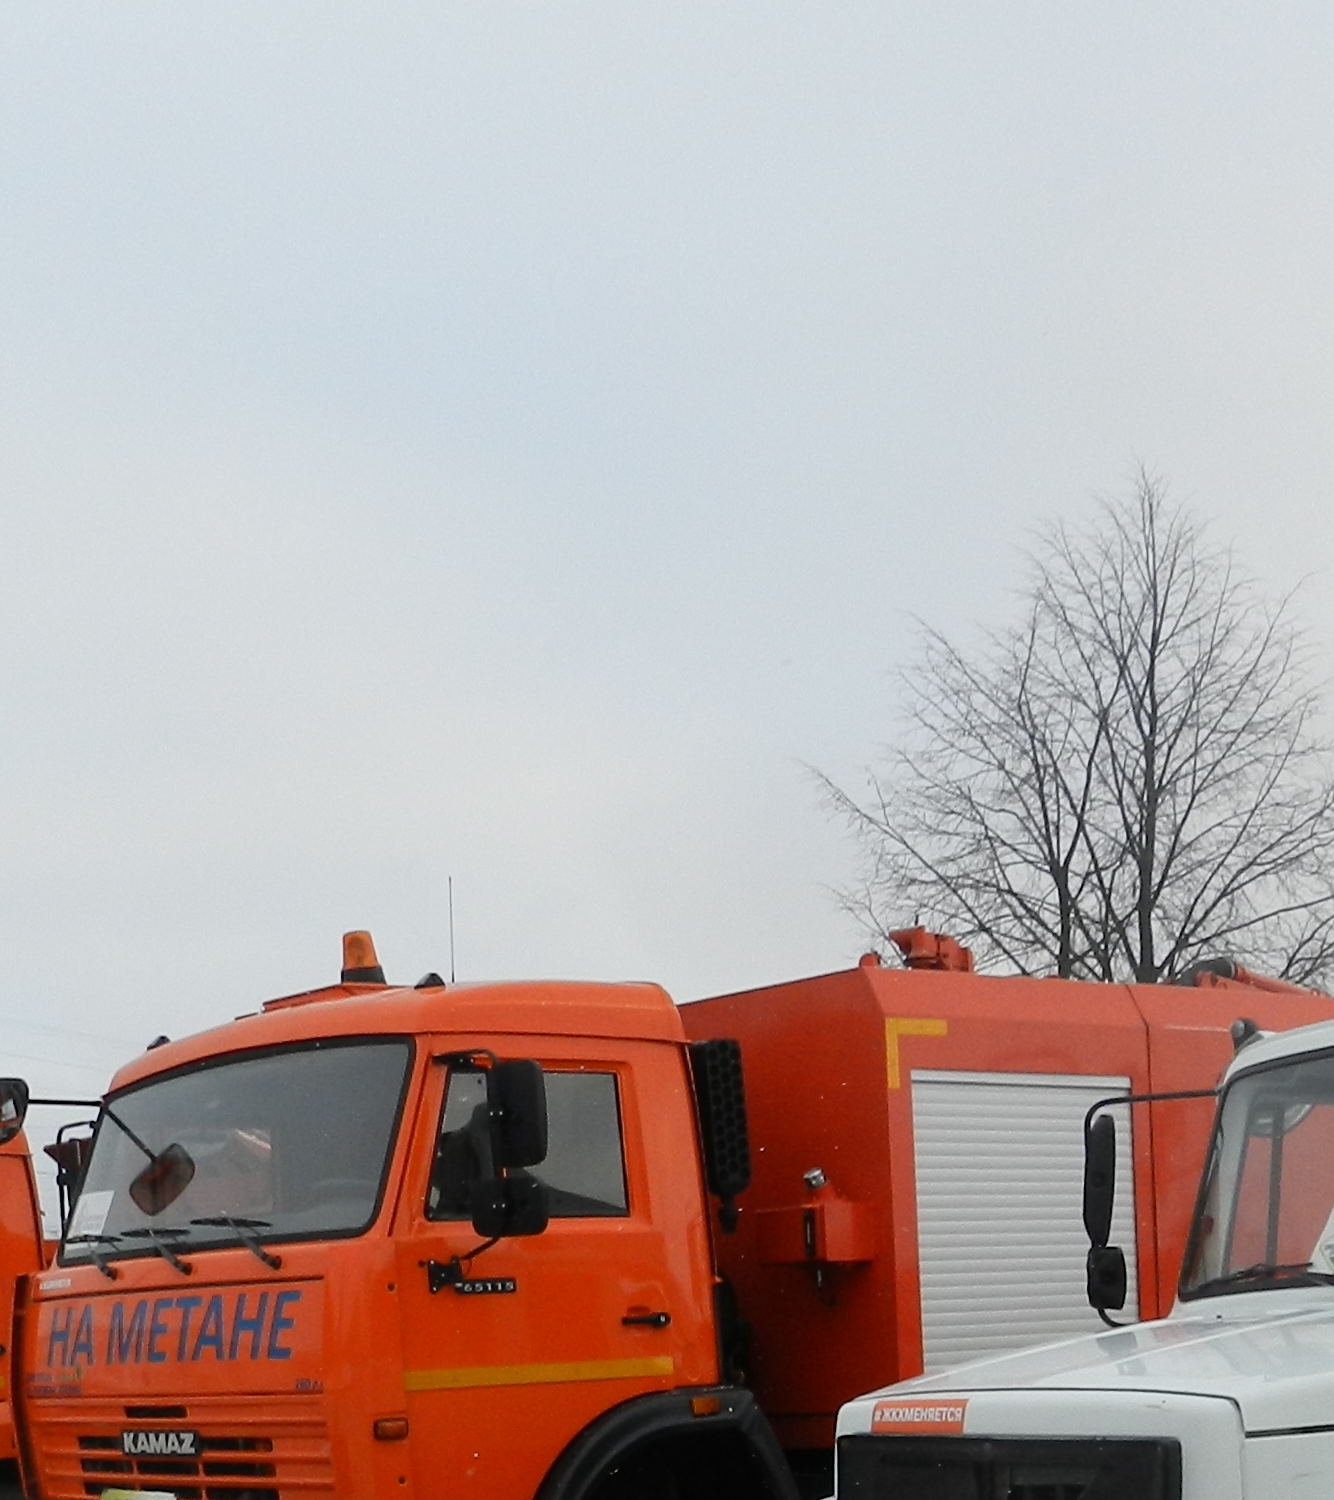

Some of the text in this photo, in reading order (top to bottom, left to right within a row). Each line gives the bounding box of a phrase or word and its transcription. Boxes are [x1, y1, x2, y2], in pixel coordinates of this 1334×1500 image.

[47, 1290, 304, 1368] НА МЕТАНЕ
[123, 1431, 196, 1455] KAMAZ
